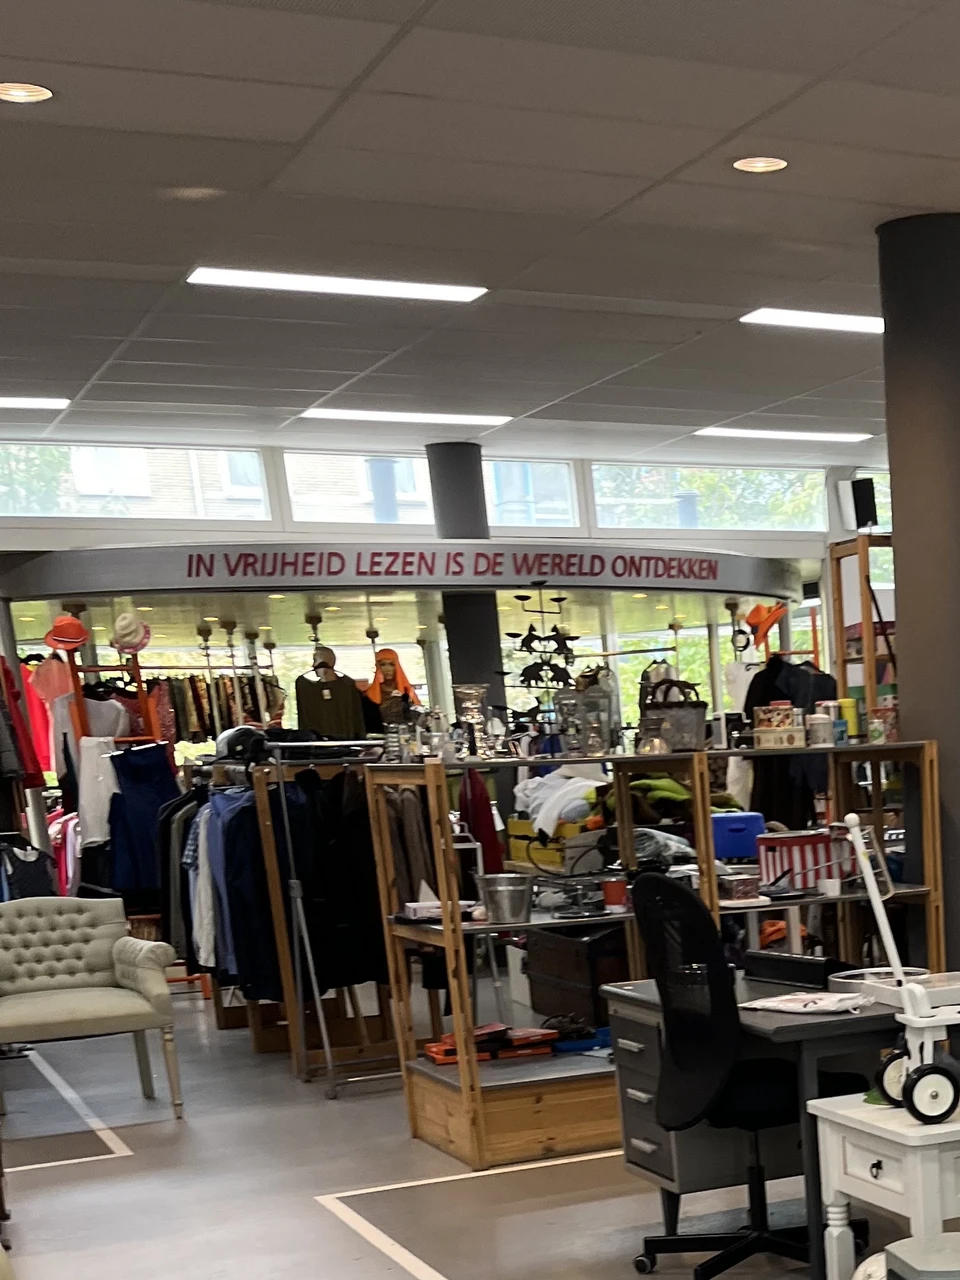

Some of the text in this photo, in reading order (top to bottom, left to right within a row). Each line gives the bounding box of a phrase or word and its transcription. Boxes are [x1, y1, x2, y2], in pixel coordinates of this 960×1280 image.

[187, 551, 719, 581] IN VRIJHEID LEZEN IS DE WERELD ONTDEKKEN
